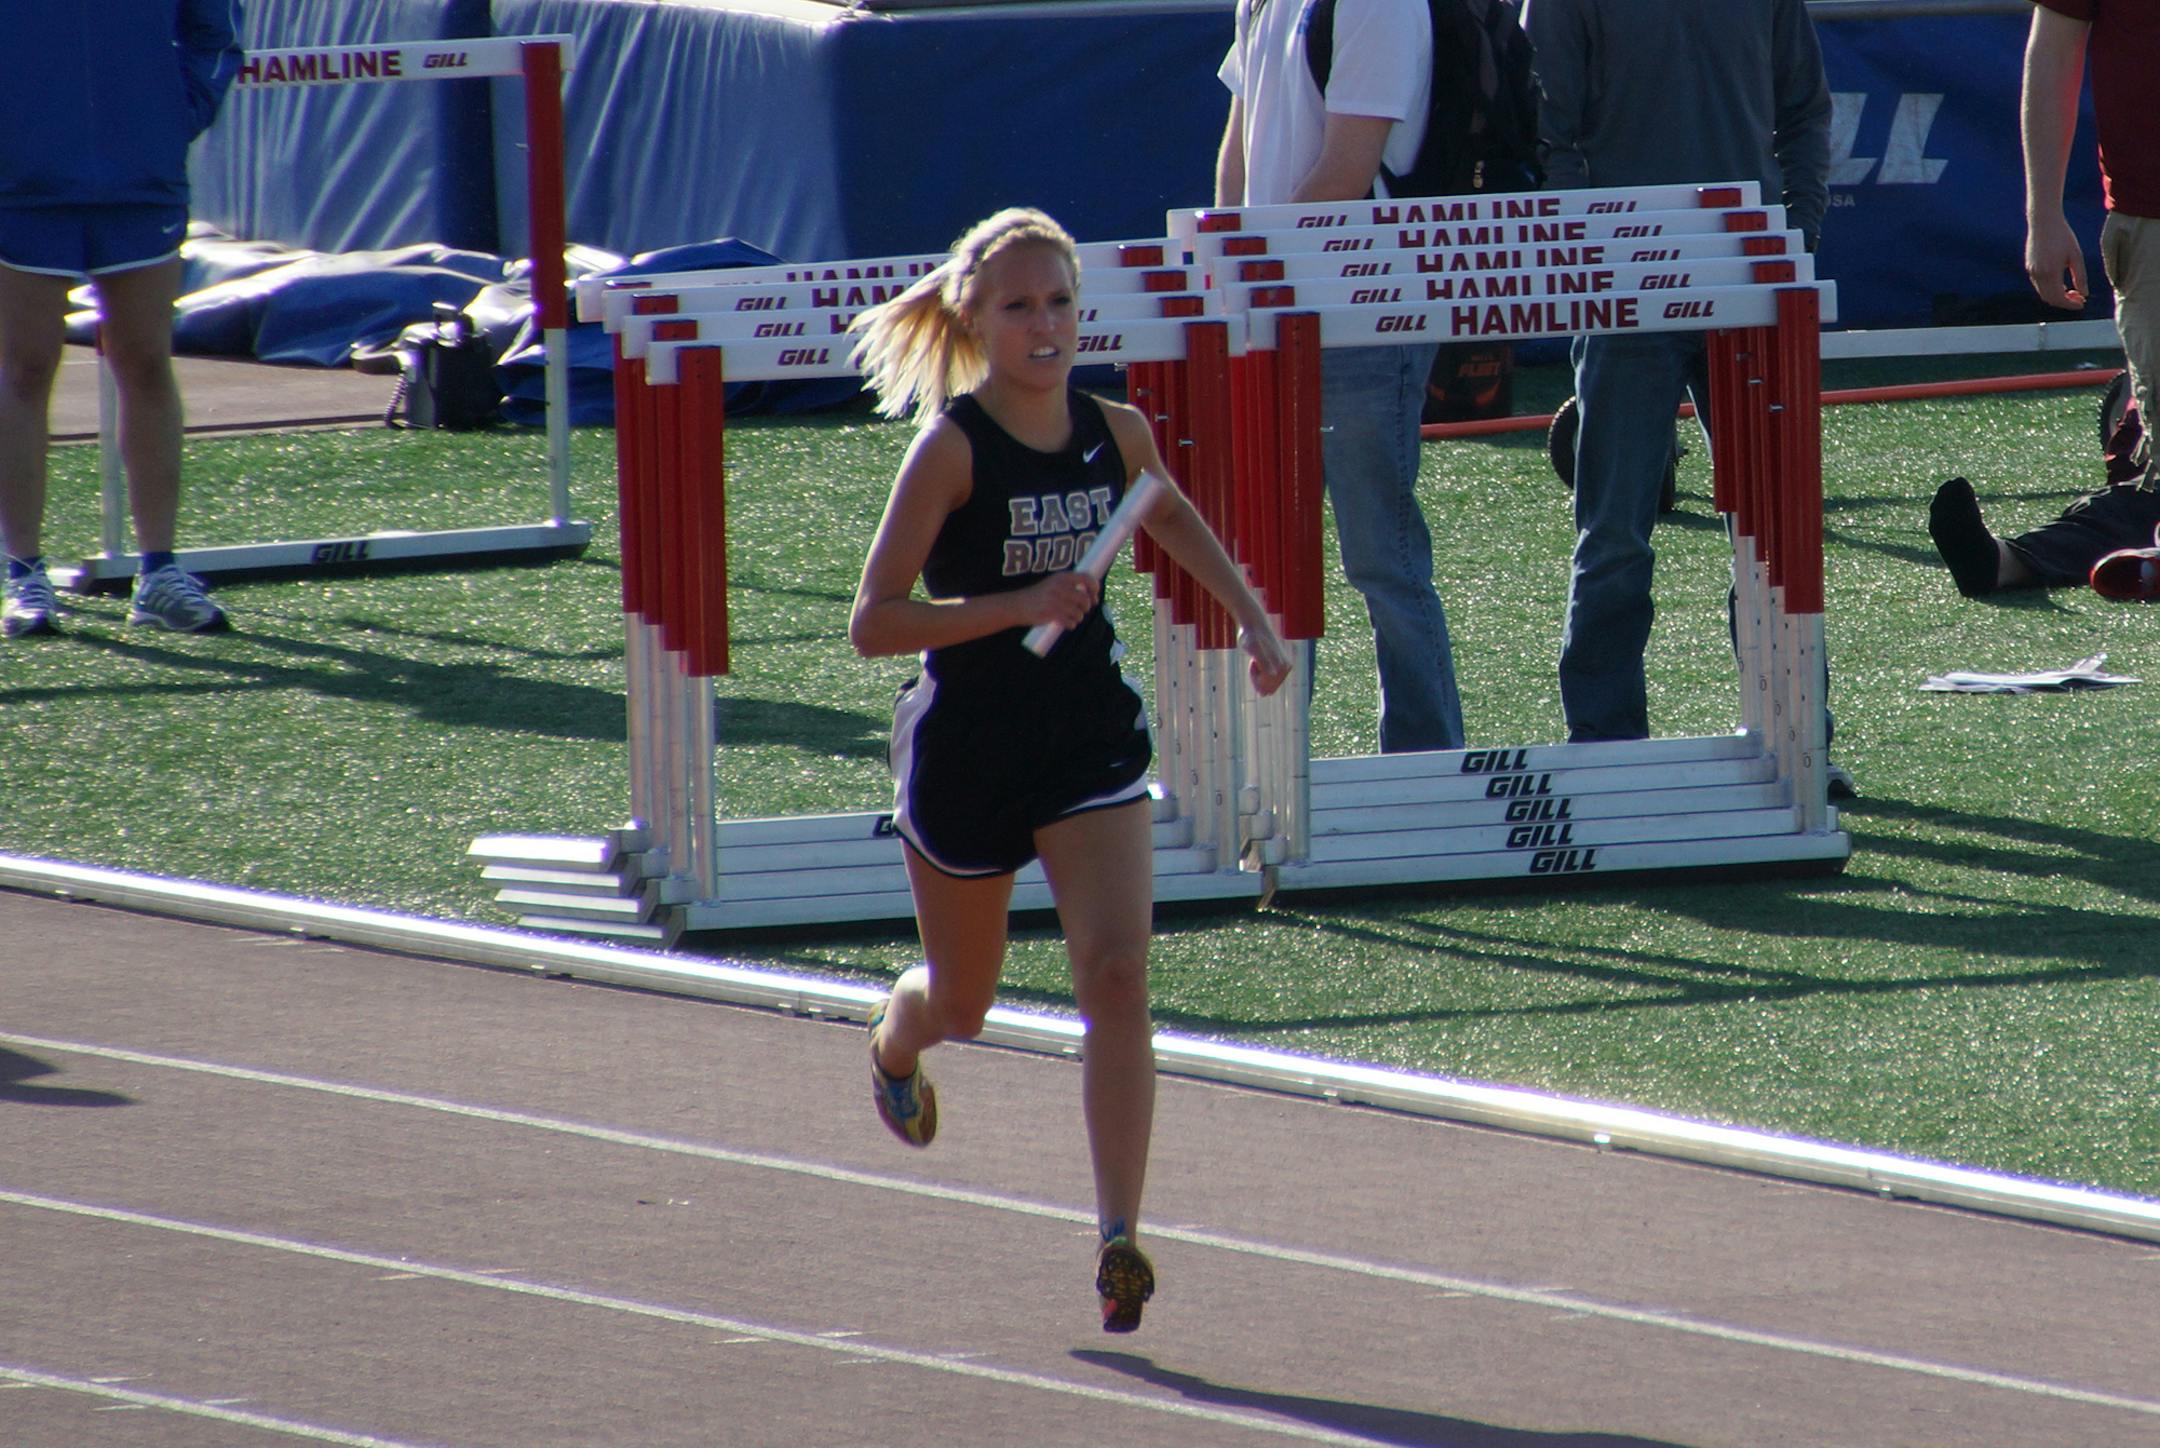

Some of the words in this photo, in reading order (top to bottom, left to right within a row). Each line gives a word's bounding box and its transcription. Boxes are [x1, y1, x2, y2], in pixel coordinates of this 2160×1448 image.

[238, 50, 402, 84] HAMLINE
[421, 52, 468, 69] GILL
[1828, 92, 1949, 185] LL
[1373, 197, 1560, 225] HAMLINE
[1399, 221, 1586, 249] HAMLINE
[1416, 246, 1604, 273] HAMLINE
[1350, 287, 1402, 304] GILL
[1426, 270, 1614, 300] HAMLINE
[1639, 273, 1691, 290] GILL
[753, 322, 806, 338] GILL
[1375, 314, 1427, 333] GILL
[1451, 298, 1640, 337] HAMLINE
[1662, 300, 1715, 319] GILL
[777, 348, 831, 367] GILL
[1008, 486, 1111, 537] EAST
[310, 541, 370, 564] GILL
[1460, 749, 1528, 774] GILL
[1485, 774, 1553, 799] GILL
[1505, 798, 1572, 823] GILL
[1506, 823, 1573, 848] GILL
[1529, 849, 1597, 874] GILL
